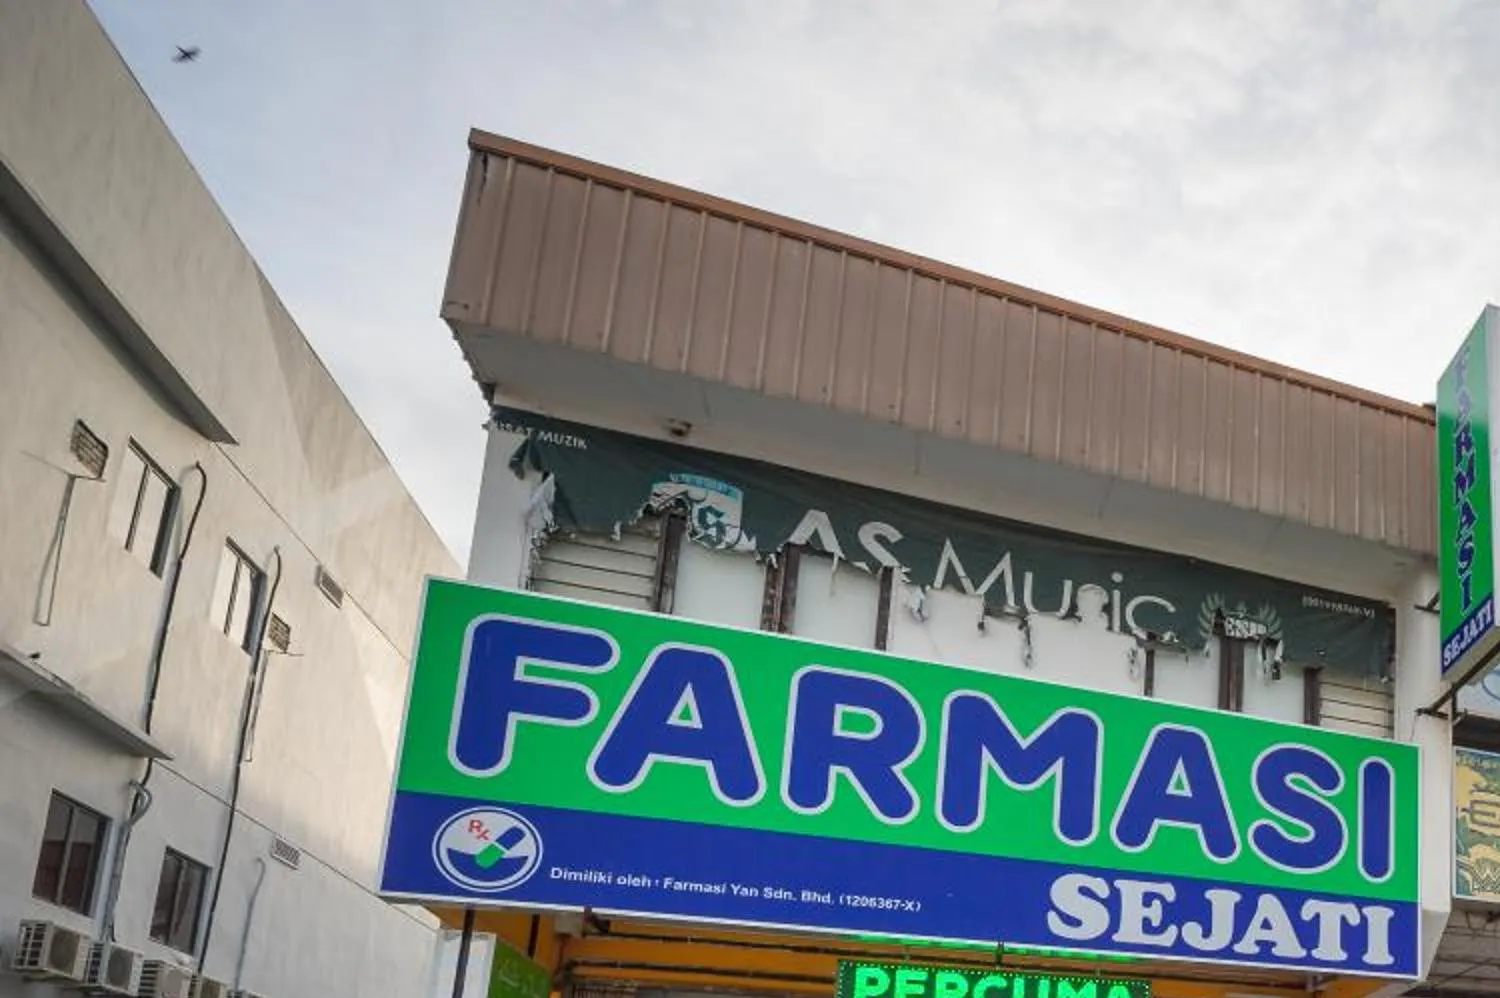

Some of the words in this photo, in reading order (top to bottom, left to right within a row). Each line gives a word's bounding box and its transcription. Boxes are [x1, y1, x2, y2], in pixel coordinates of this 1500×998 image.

[540, 430, 588, 451] MUZIK
[1443, 599, 1494, 668] SEJATI
[448, 613, 1396, 883] FARMASI
[551, 867, 613, 885] Dimiliki
[616, 873, 651, 888] oleh
[664, 877, 726, 895] Farmasi
[731, 883, 759, 897] Yan
[1046, 873, 1396, 966] SEJATI
